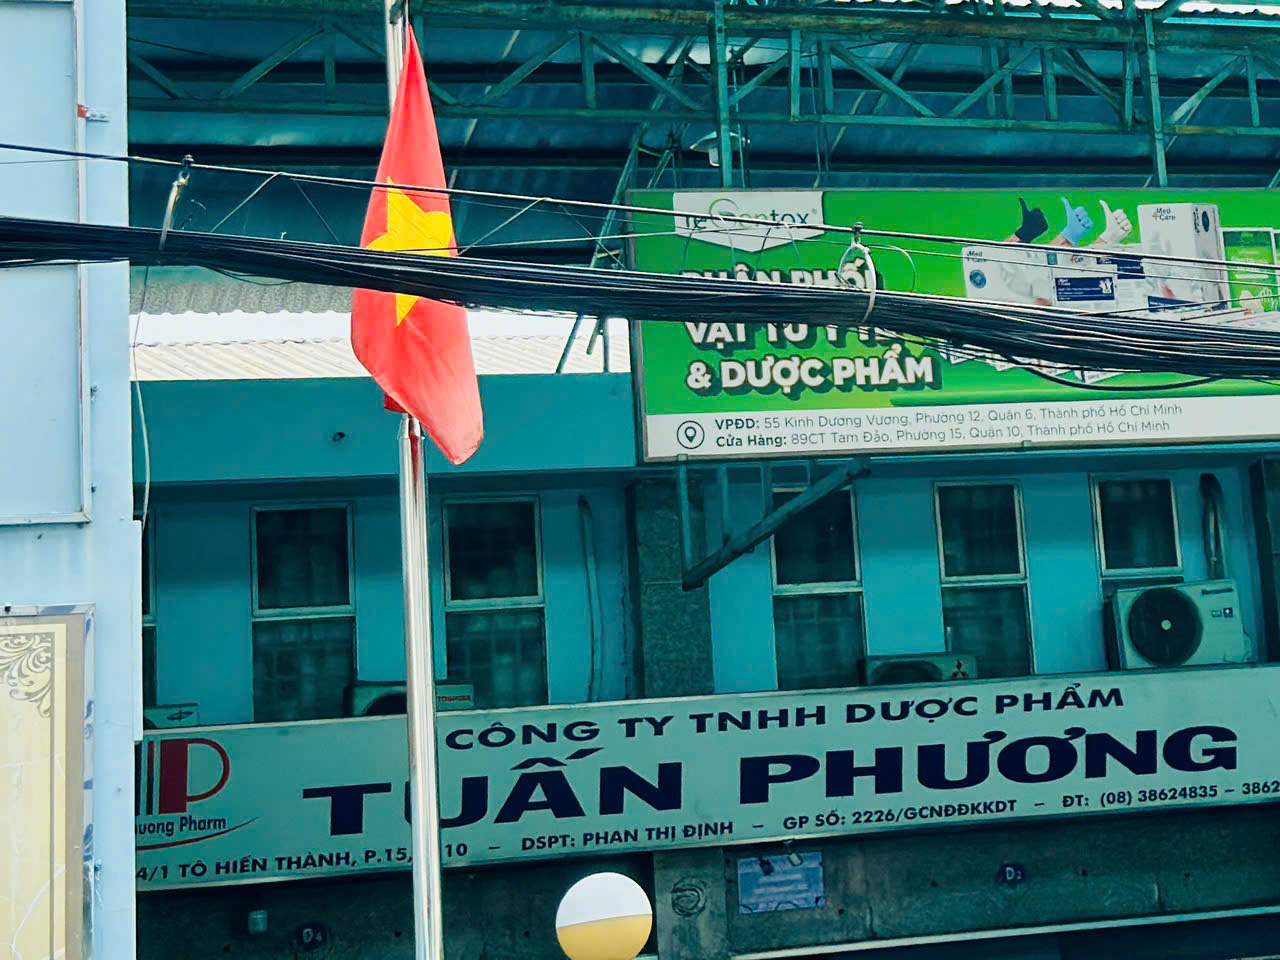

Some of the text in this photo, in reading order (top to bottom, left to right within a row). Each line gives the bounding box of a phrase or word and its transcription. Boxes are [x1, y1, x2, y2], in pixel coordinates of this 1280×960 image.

[686, 343, 934, 394] & DƯỢC PHẨM
[715, 418, 760, 430] VPĐD:
[764, 417, 781, 428] 55
[785, 416, 814, 428] Kinh
[1153, 403, 1182, 415] Minh
[716, 433, 743, 447] Cửa
[832, 431, 859, 443] Tam
[1141, 420, 1170, 432] Minh
[445, 683, 1124, 750] CÔNG TY TNHH DƯỢC PHẨM
[302, 725, 1238, 837] TUẤN PHƯƠNG
[179, 816, 227, 832] Pharm
[179, 860, 207, 878] TÔ
[275, 850, 357, 871] THÀNH,
[521, 835, 576, 851] DSPT:
[583, 829, 639, 847] PHAN
[645, 825, 676, 843] THỊ
[683, 821, 734, 840] ĐỊNH
[783, 814, 810, 831] GP
[1062, 793, 1090, 809] ĐT:
[1099, 789, 1133, 809] (08)
[1138, 783, 1218, 803] 38624835
